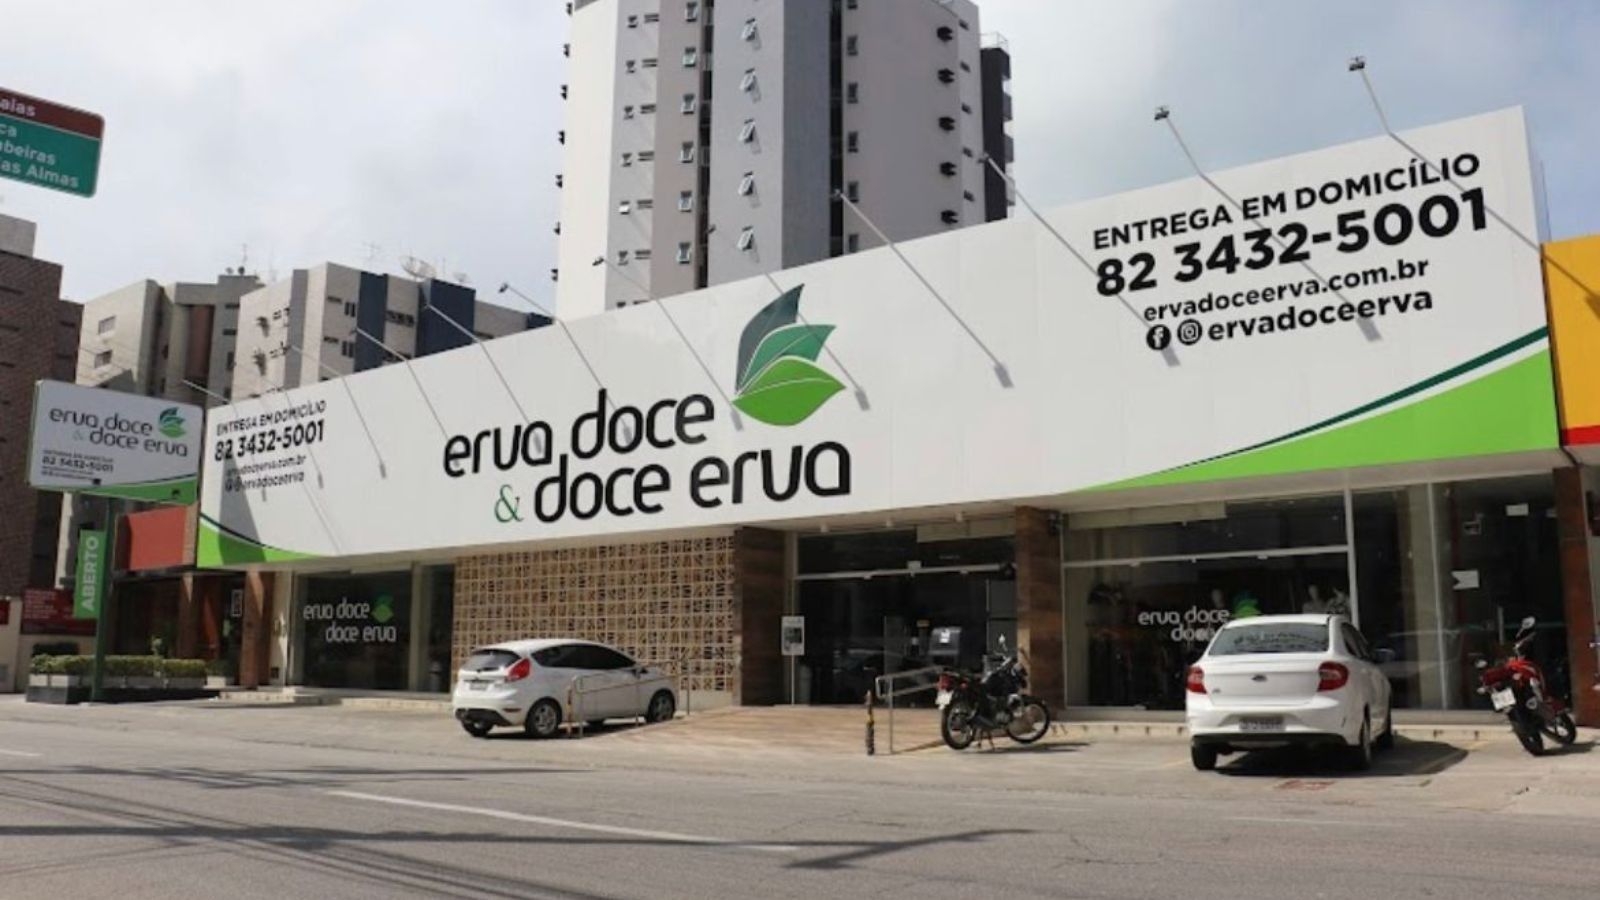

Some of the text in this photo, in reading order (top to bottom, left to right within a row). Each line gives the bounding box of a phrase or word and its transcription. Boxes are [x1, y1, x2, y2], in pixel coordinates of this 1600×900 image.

[26, 164, 79, 188] Almas
[1093, 152, 1480, 250] ENTREGA EM DOMICÍLIO
[1096, 188, 1487, 297] 82 3432-5001
[1144, 258, 1429, 322] ervadoceerva.com.br
[1208, 290, 1434, 342] ervadoceerva
[89, 425, 139, 449] doce
[104, 412, 153, 436] doce
[214, 419, 325, 462] 82 3432-5001
[217, 417, 258, 436] ENTREGA
[571, 388, 715, 460] doce
[493, 483, 524, 523] &
[534, 453, 671, 523] doce
[82, 536, 99, 611] ABERTO
[336, 597, 370, 619] doce
[1184, 605, 1230, 623] doce
[325, 622, 359, 642] doce
